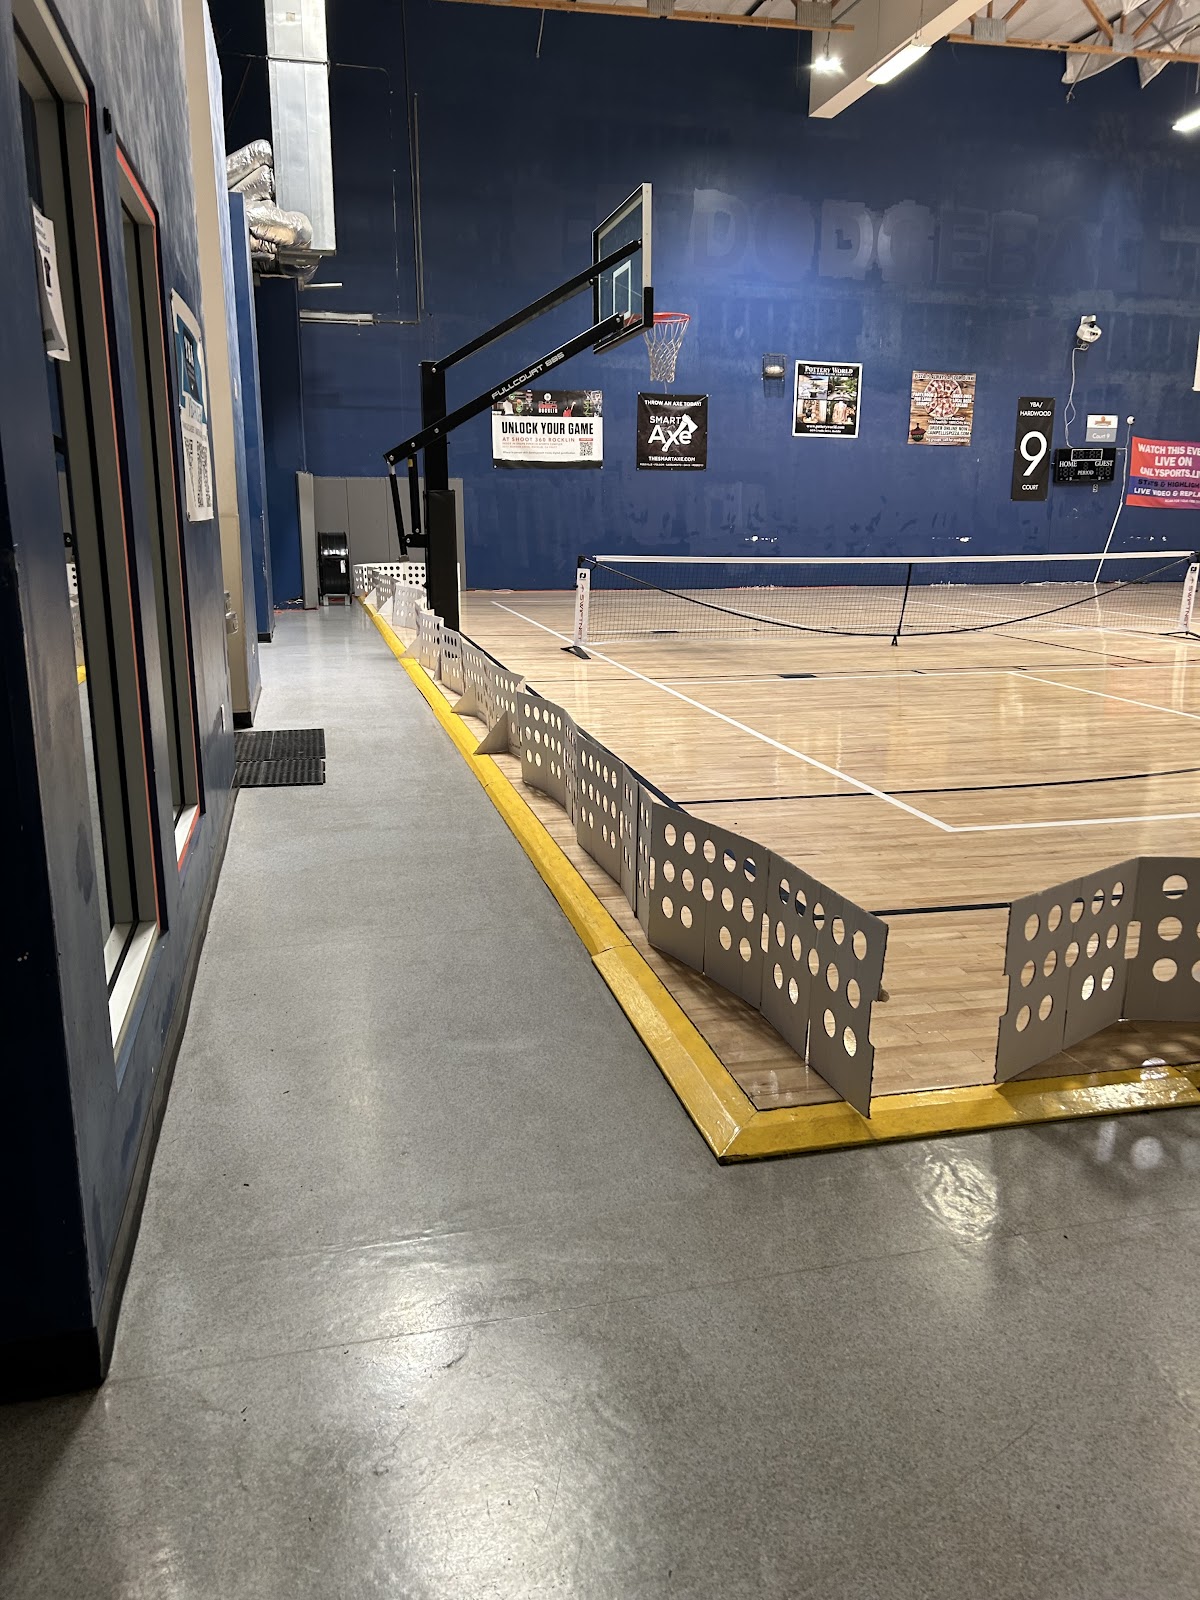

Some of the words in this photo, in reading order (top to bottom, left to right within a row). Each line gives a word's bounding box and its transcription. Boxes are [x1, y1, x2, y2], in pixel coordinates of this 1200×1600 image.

[804, 365, 831, 374] POTTERY
[832, 366, 853, 374] WORLD
[491, 364, 543, 400] FULLCOURT
[650, 415, 681, 424] SMART
[502, 422, 538, 434] UNLOCK
[541, 422, 565, 434] YOUR
[568, 422, 594, 434] GAME
[1020, 431, 1047, 476] 9
[1137, 443, 1166, 454] WATCH
[1167, 446, 1186, 455] THIS
[1154, 456, 1176, 466] LIVE
[1177, 456, 1192, 467] ON
[1133, 487, 1151, 495] LIVE
